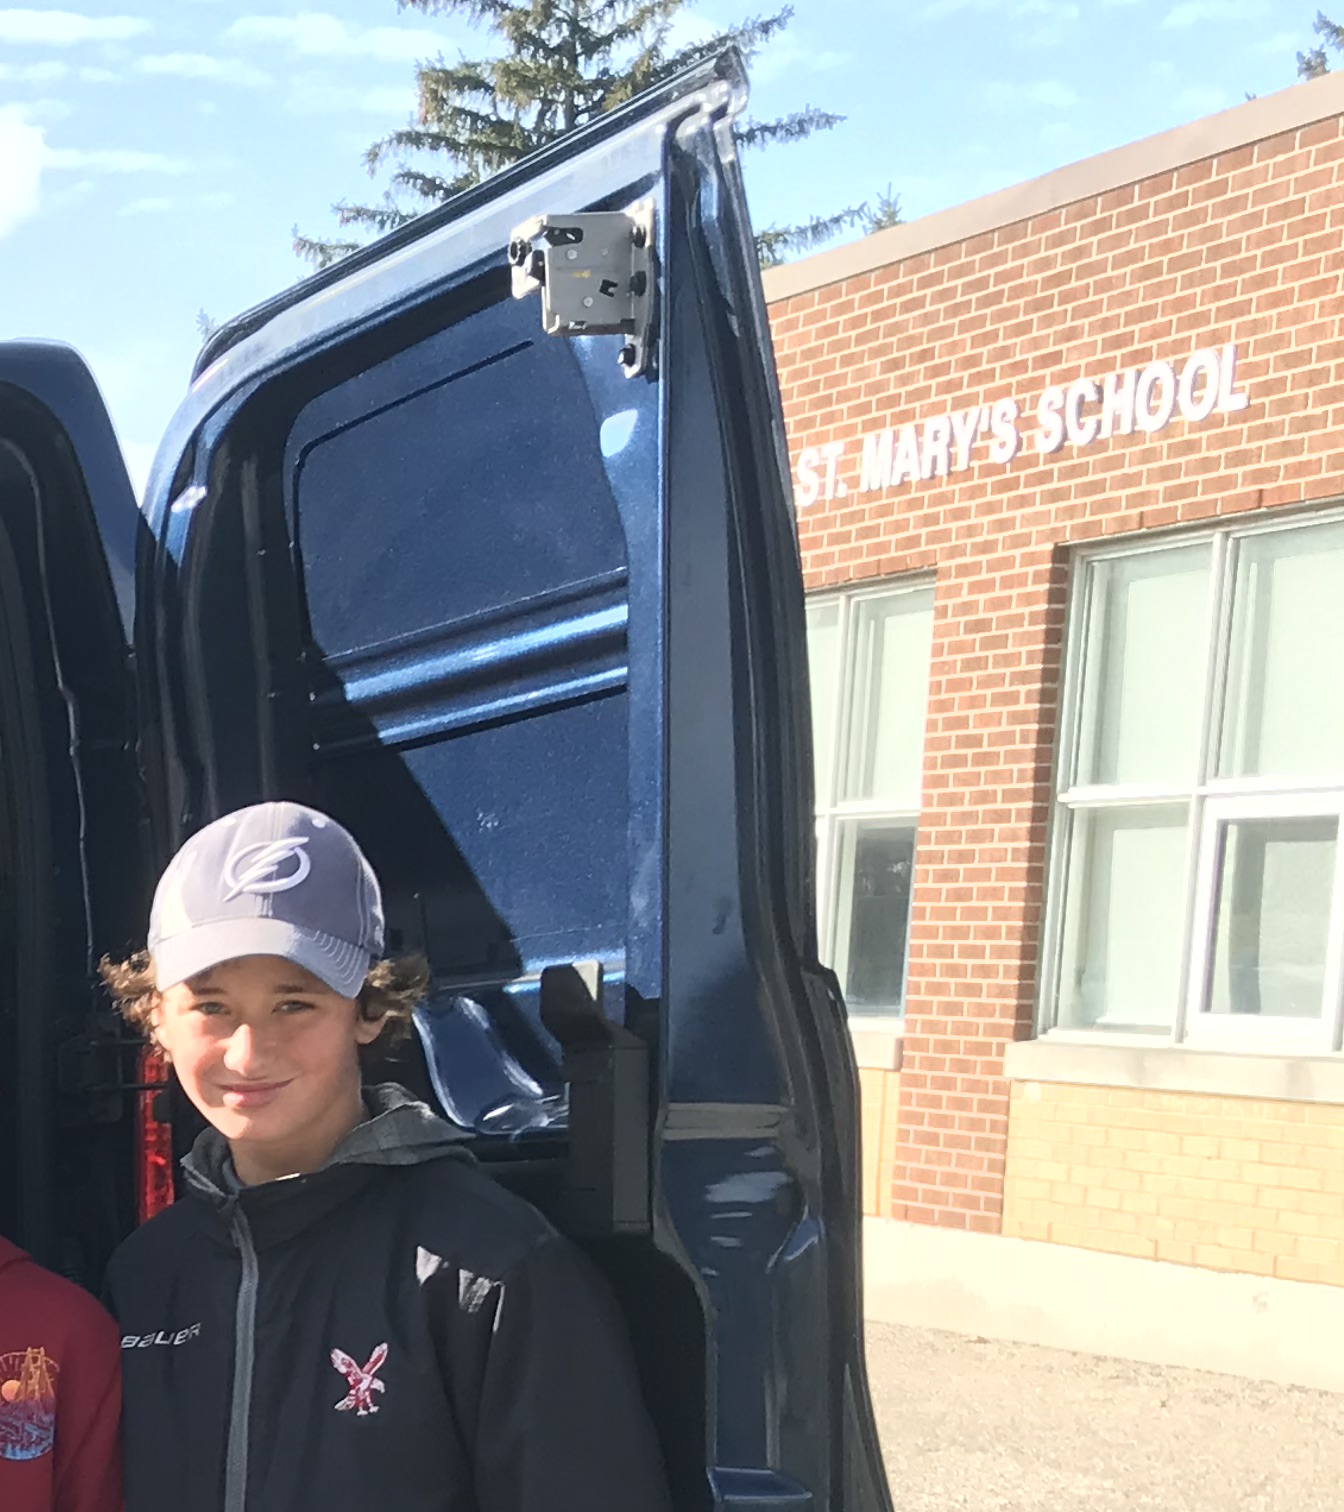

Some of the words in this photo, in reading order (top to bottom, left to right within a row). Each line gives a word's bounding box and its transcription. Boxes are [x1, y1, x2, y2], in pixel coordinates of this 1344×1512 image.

[796, 442, 848, 507] ST.
[859, 396, 1021, 494] MARY'S
[1033, 343, 1250, 454] SCHOOL
[120, 1322, 202, 1350] BAUER
